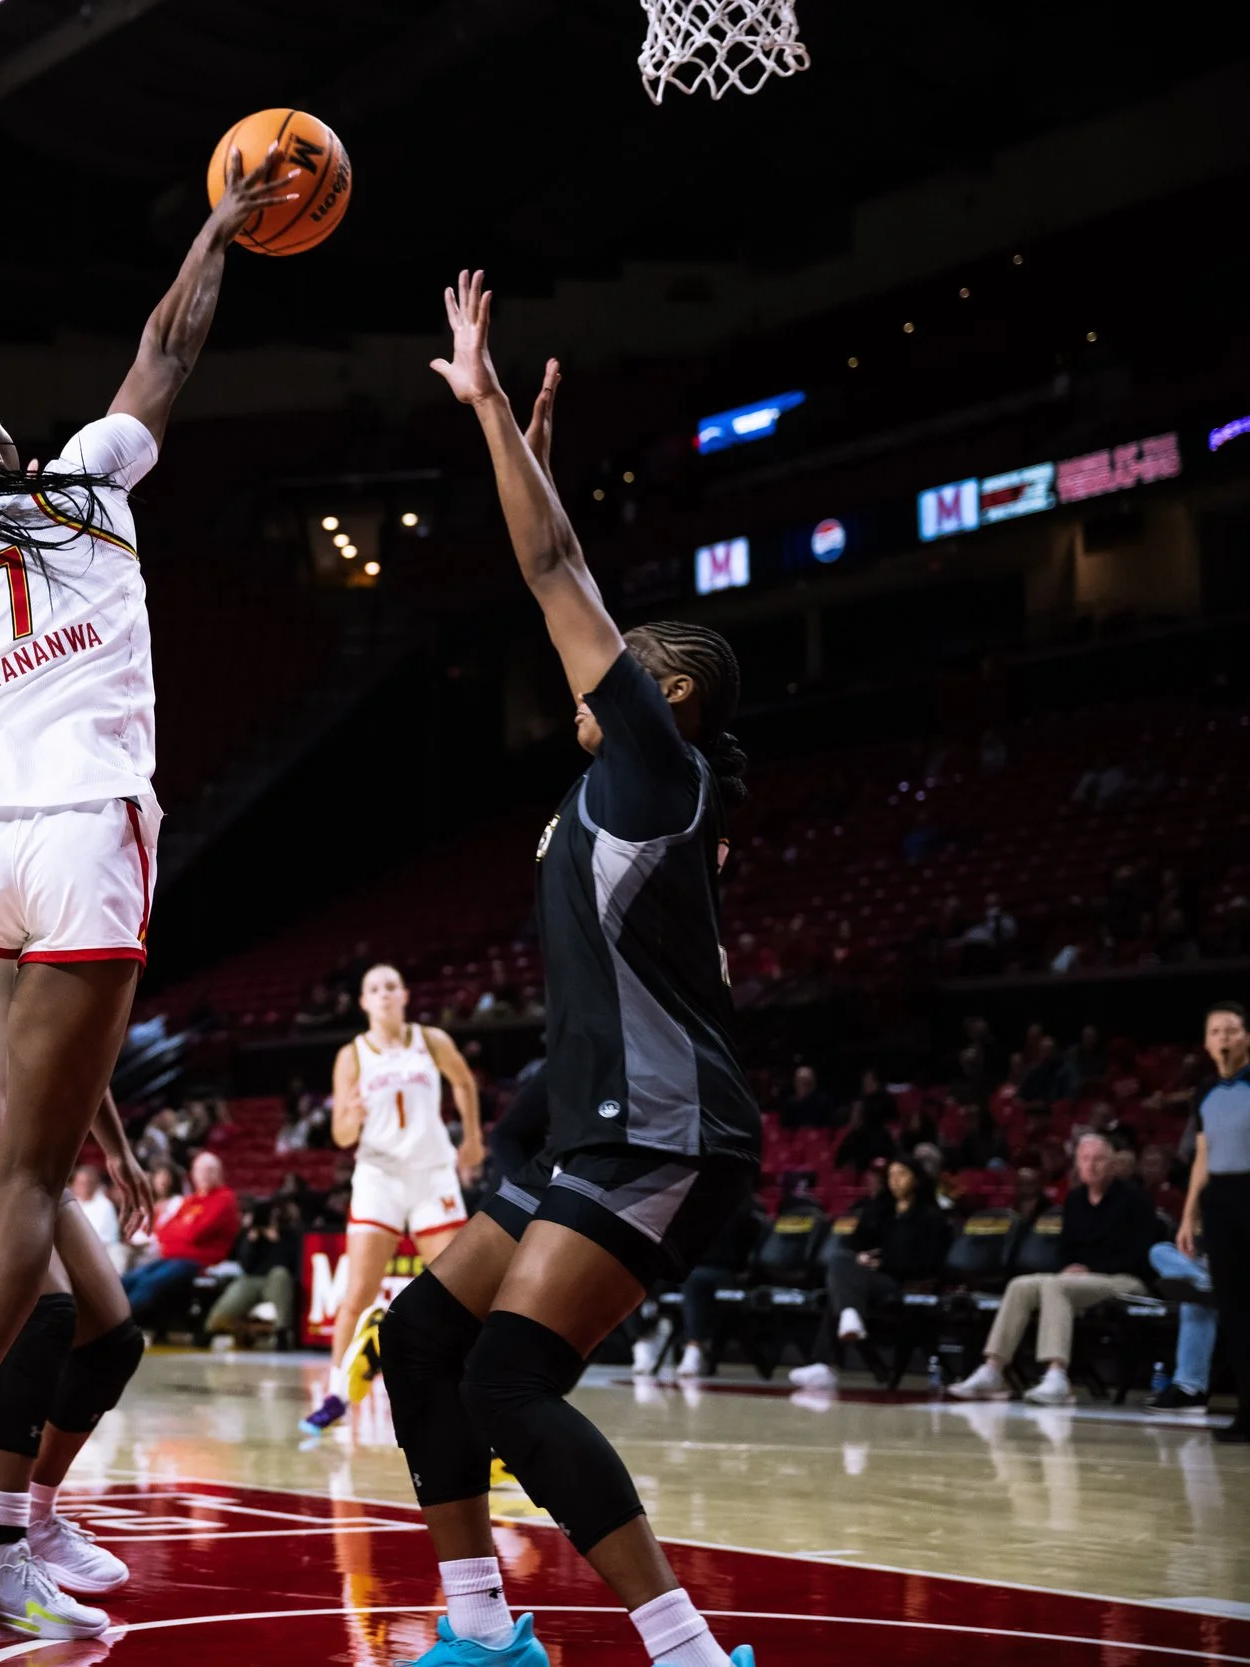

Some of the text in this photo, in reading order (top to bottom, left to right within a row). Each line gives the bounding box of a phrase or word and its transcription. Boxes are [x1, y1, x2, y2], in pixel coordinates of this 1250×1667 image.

[289, 137, 324, 176] M
[394, 1090, 406, 1129] 1
[309, 1252, 350, 1324] M
